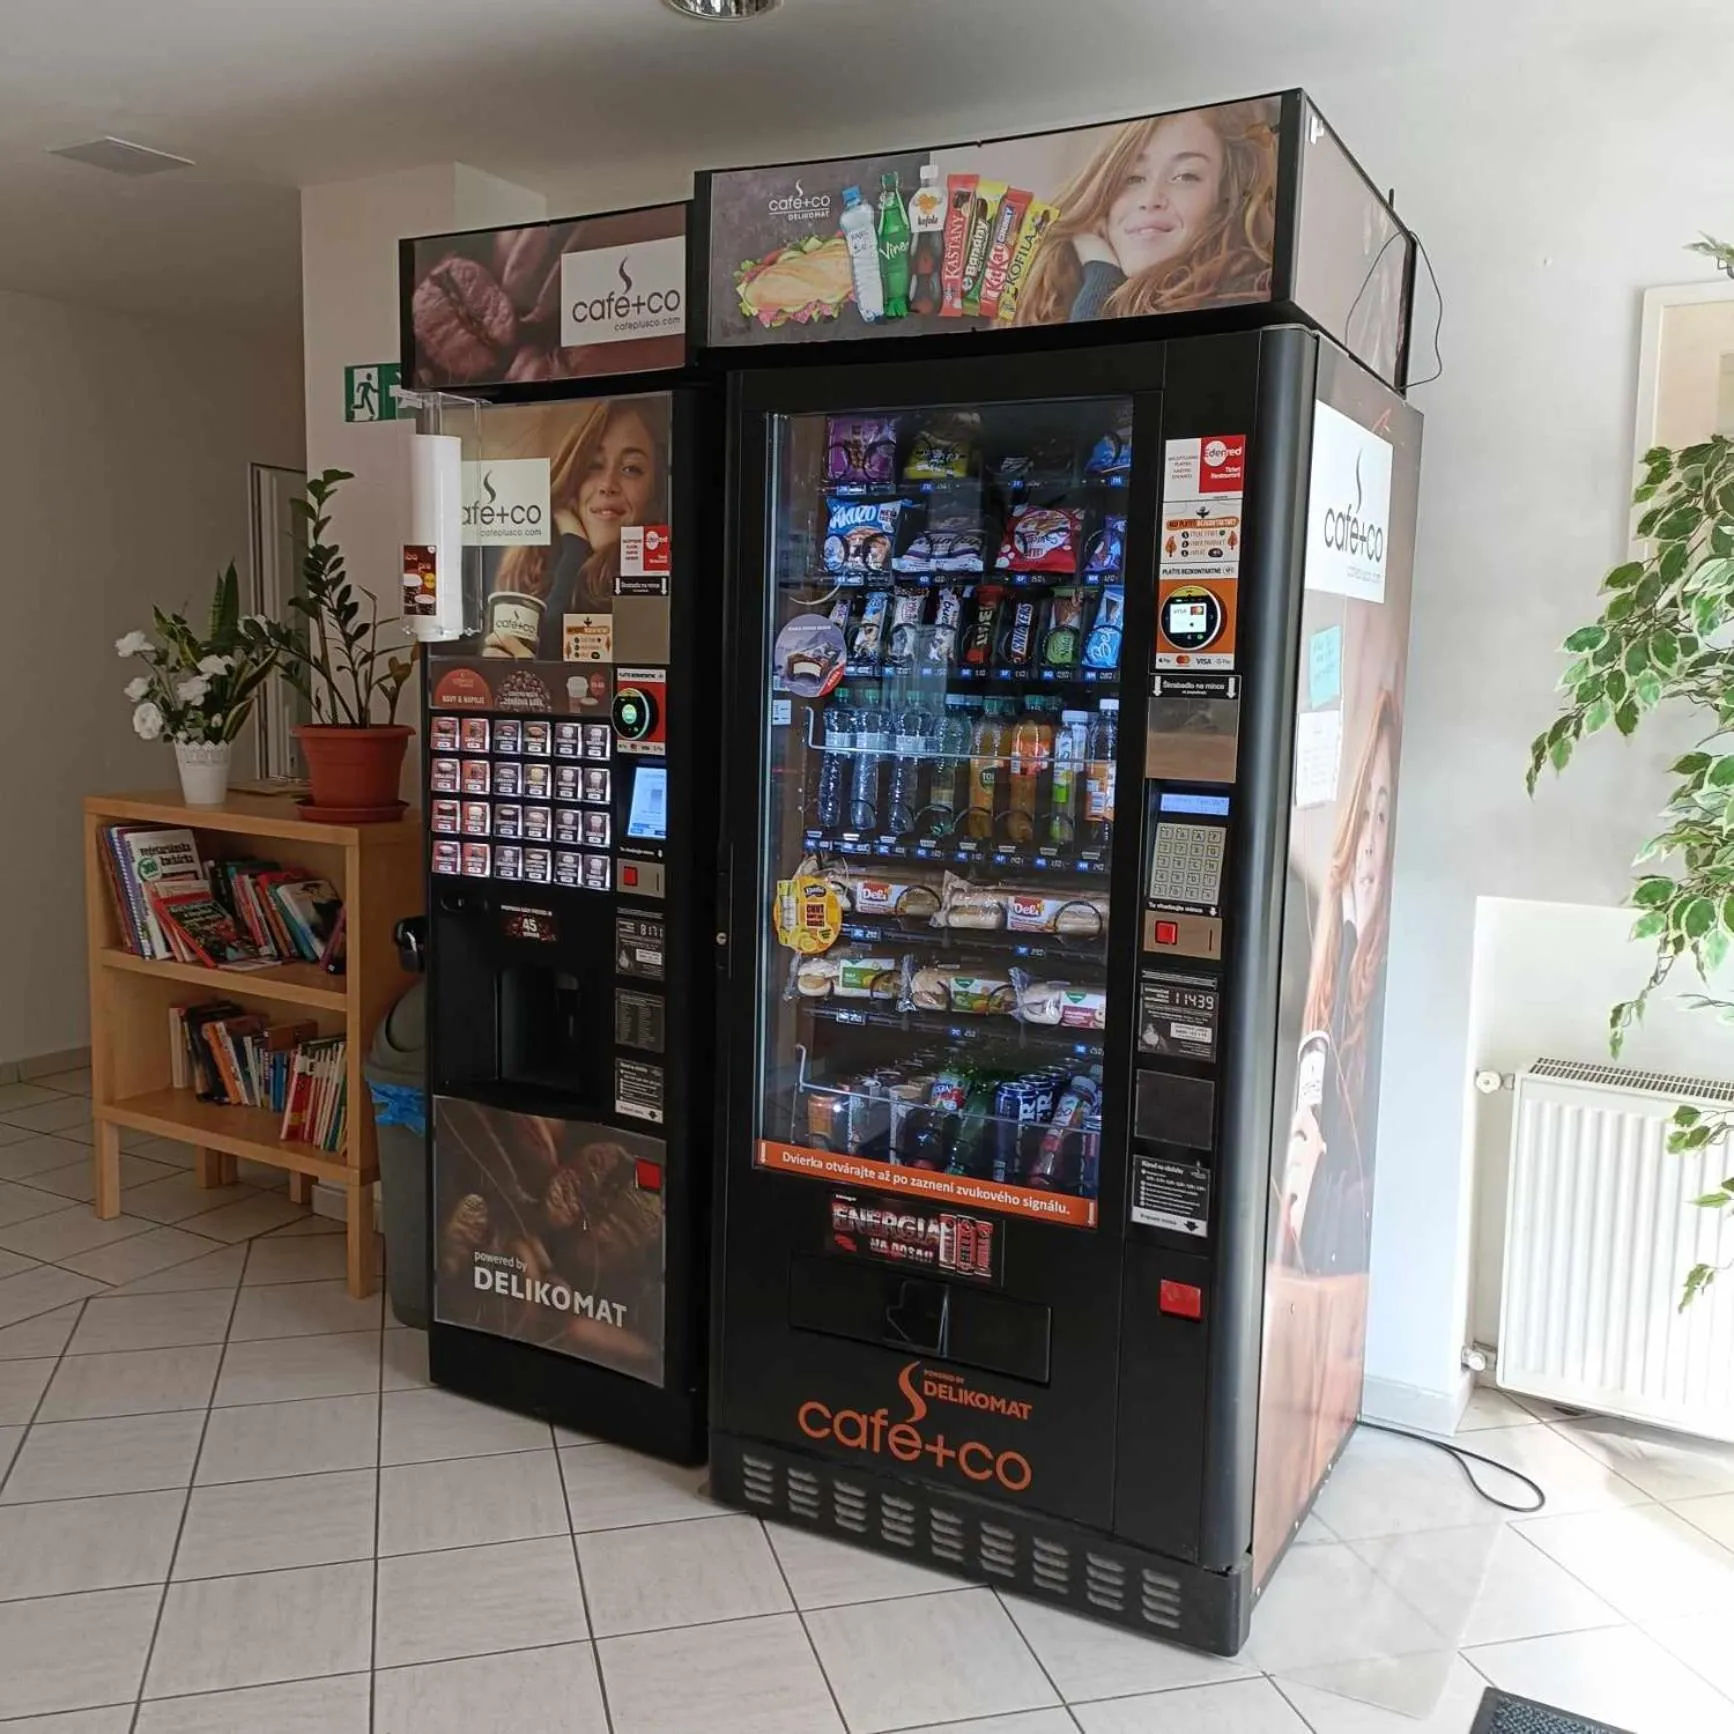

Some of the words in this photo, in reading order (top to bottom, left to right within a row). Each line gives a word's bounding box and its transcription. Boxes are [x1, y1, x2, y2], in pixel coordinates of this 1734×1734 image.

[944, 215, 964, 280] KAŠTANY
[983, 243, 1010, 298] KitKat
[1004, 233, 1035, 288] KOFILA
[461, 500, 542, 526] afé+co
[523, 918, 537, 932] 45
[782, 1151, 823, 1169] Dvierka
[826, 1162, 876, 1180] otvárajte
[877, 1170, 891, 1182] až
[893, 1174, 908, 1185] po
[910, 1177, 954, 1192] zaznení
[956, 1184, 1021, 1206] zvukového
[1022, 1197, 1071, 1215] signálu.
[474, 1250, 514, 1267] powered
[515, 1259, 528, 1272] by
[473, 1266, 628, 1328] DELIKOMAT
[923, 1379, 1033, 1421] DELIKOMAT
